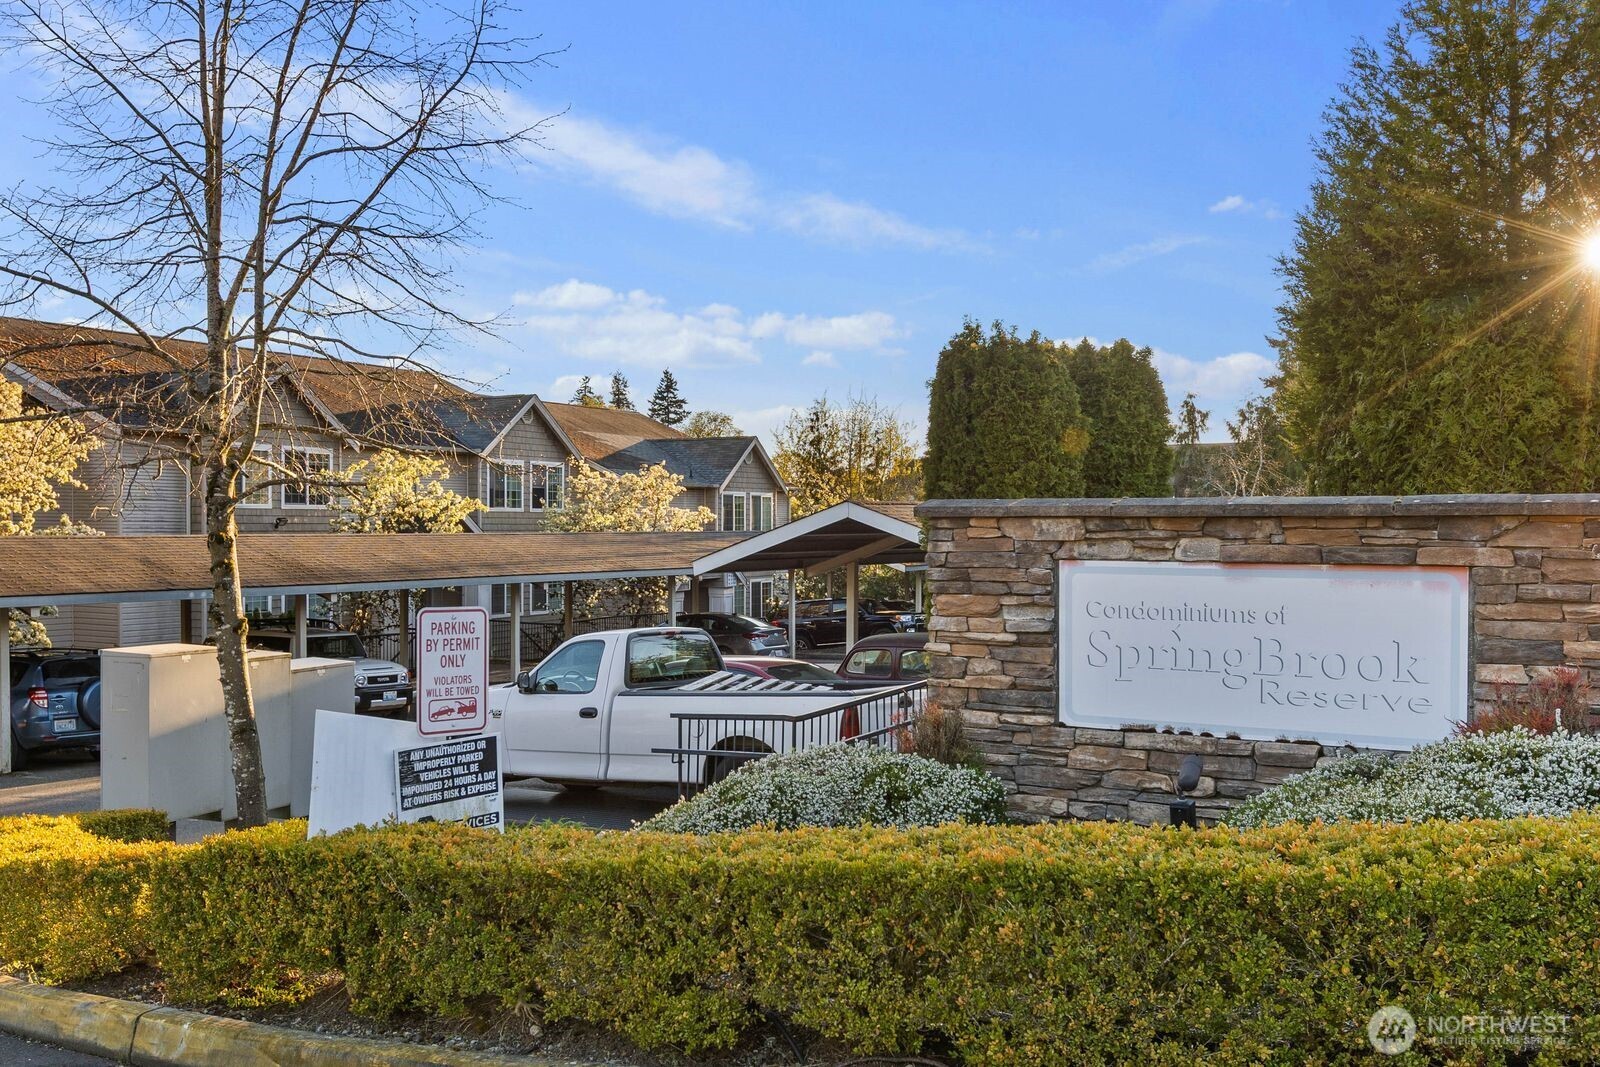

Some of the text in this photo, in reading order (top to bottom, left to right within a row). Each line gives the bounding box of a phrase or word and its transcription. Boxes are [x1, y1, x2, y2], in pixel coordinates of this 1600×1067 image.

[1086, 601, 1287, 626] Condominiums of
[430, 621, 476, 636] PARKING
[426, 636, 481, 653] BY PERMIT
[440, 654, 467, 669] ONLY
[433, 674, 473, 686] VIOLATORS
[425, 685, 480, 698] WILL BE TOWED
[1259, 678, 1433, 715] Reserve
[410, 740, 487, 761] ANY UNAUTHORIZED OR
[413, 751, 484, 772] IMPROPERLY PARKED
[420, 763, 480, 782] VEHICLES WILL BE
[402, 770, 497, 797] IMPOUNDED 24 HOURS A DAY
[403, 781, 497, 808] AT OWNERS RISK & EXPENSE
